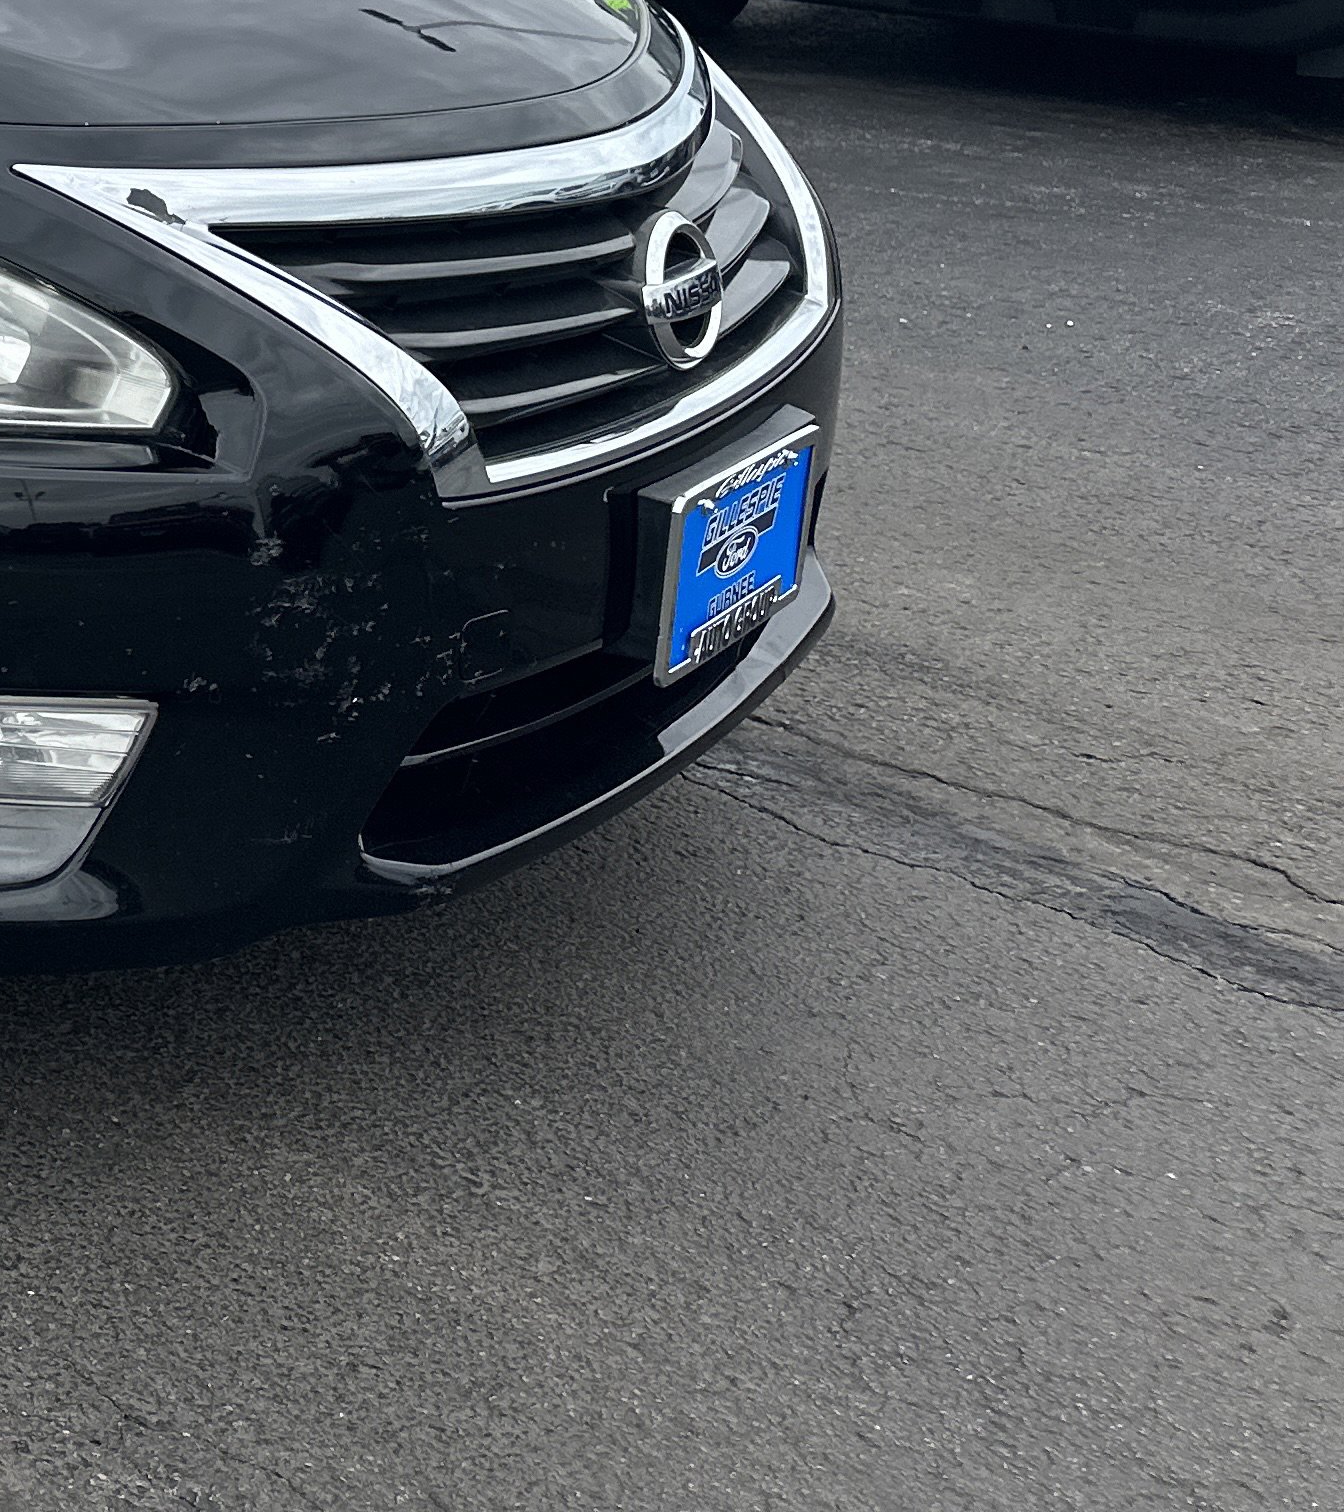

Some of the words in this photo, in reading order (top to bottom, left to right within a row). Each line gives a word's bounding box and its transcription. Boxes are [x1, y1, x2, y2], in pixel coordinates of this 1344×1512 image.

[702, 473, 787, 548] GILLESPIE
[722, 537, 753, 572] Ford
[707, 569, 756, 621] GURNEE
